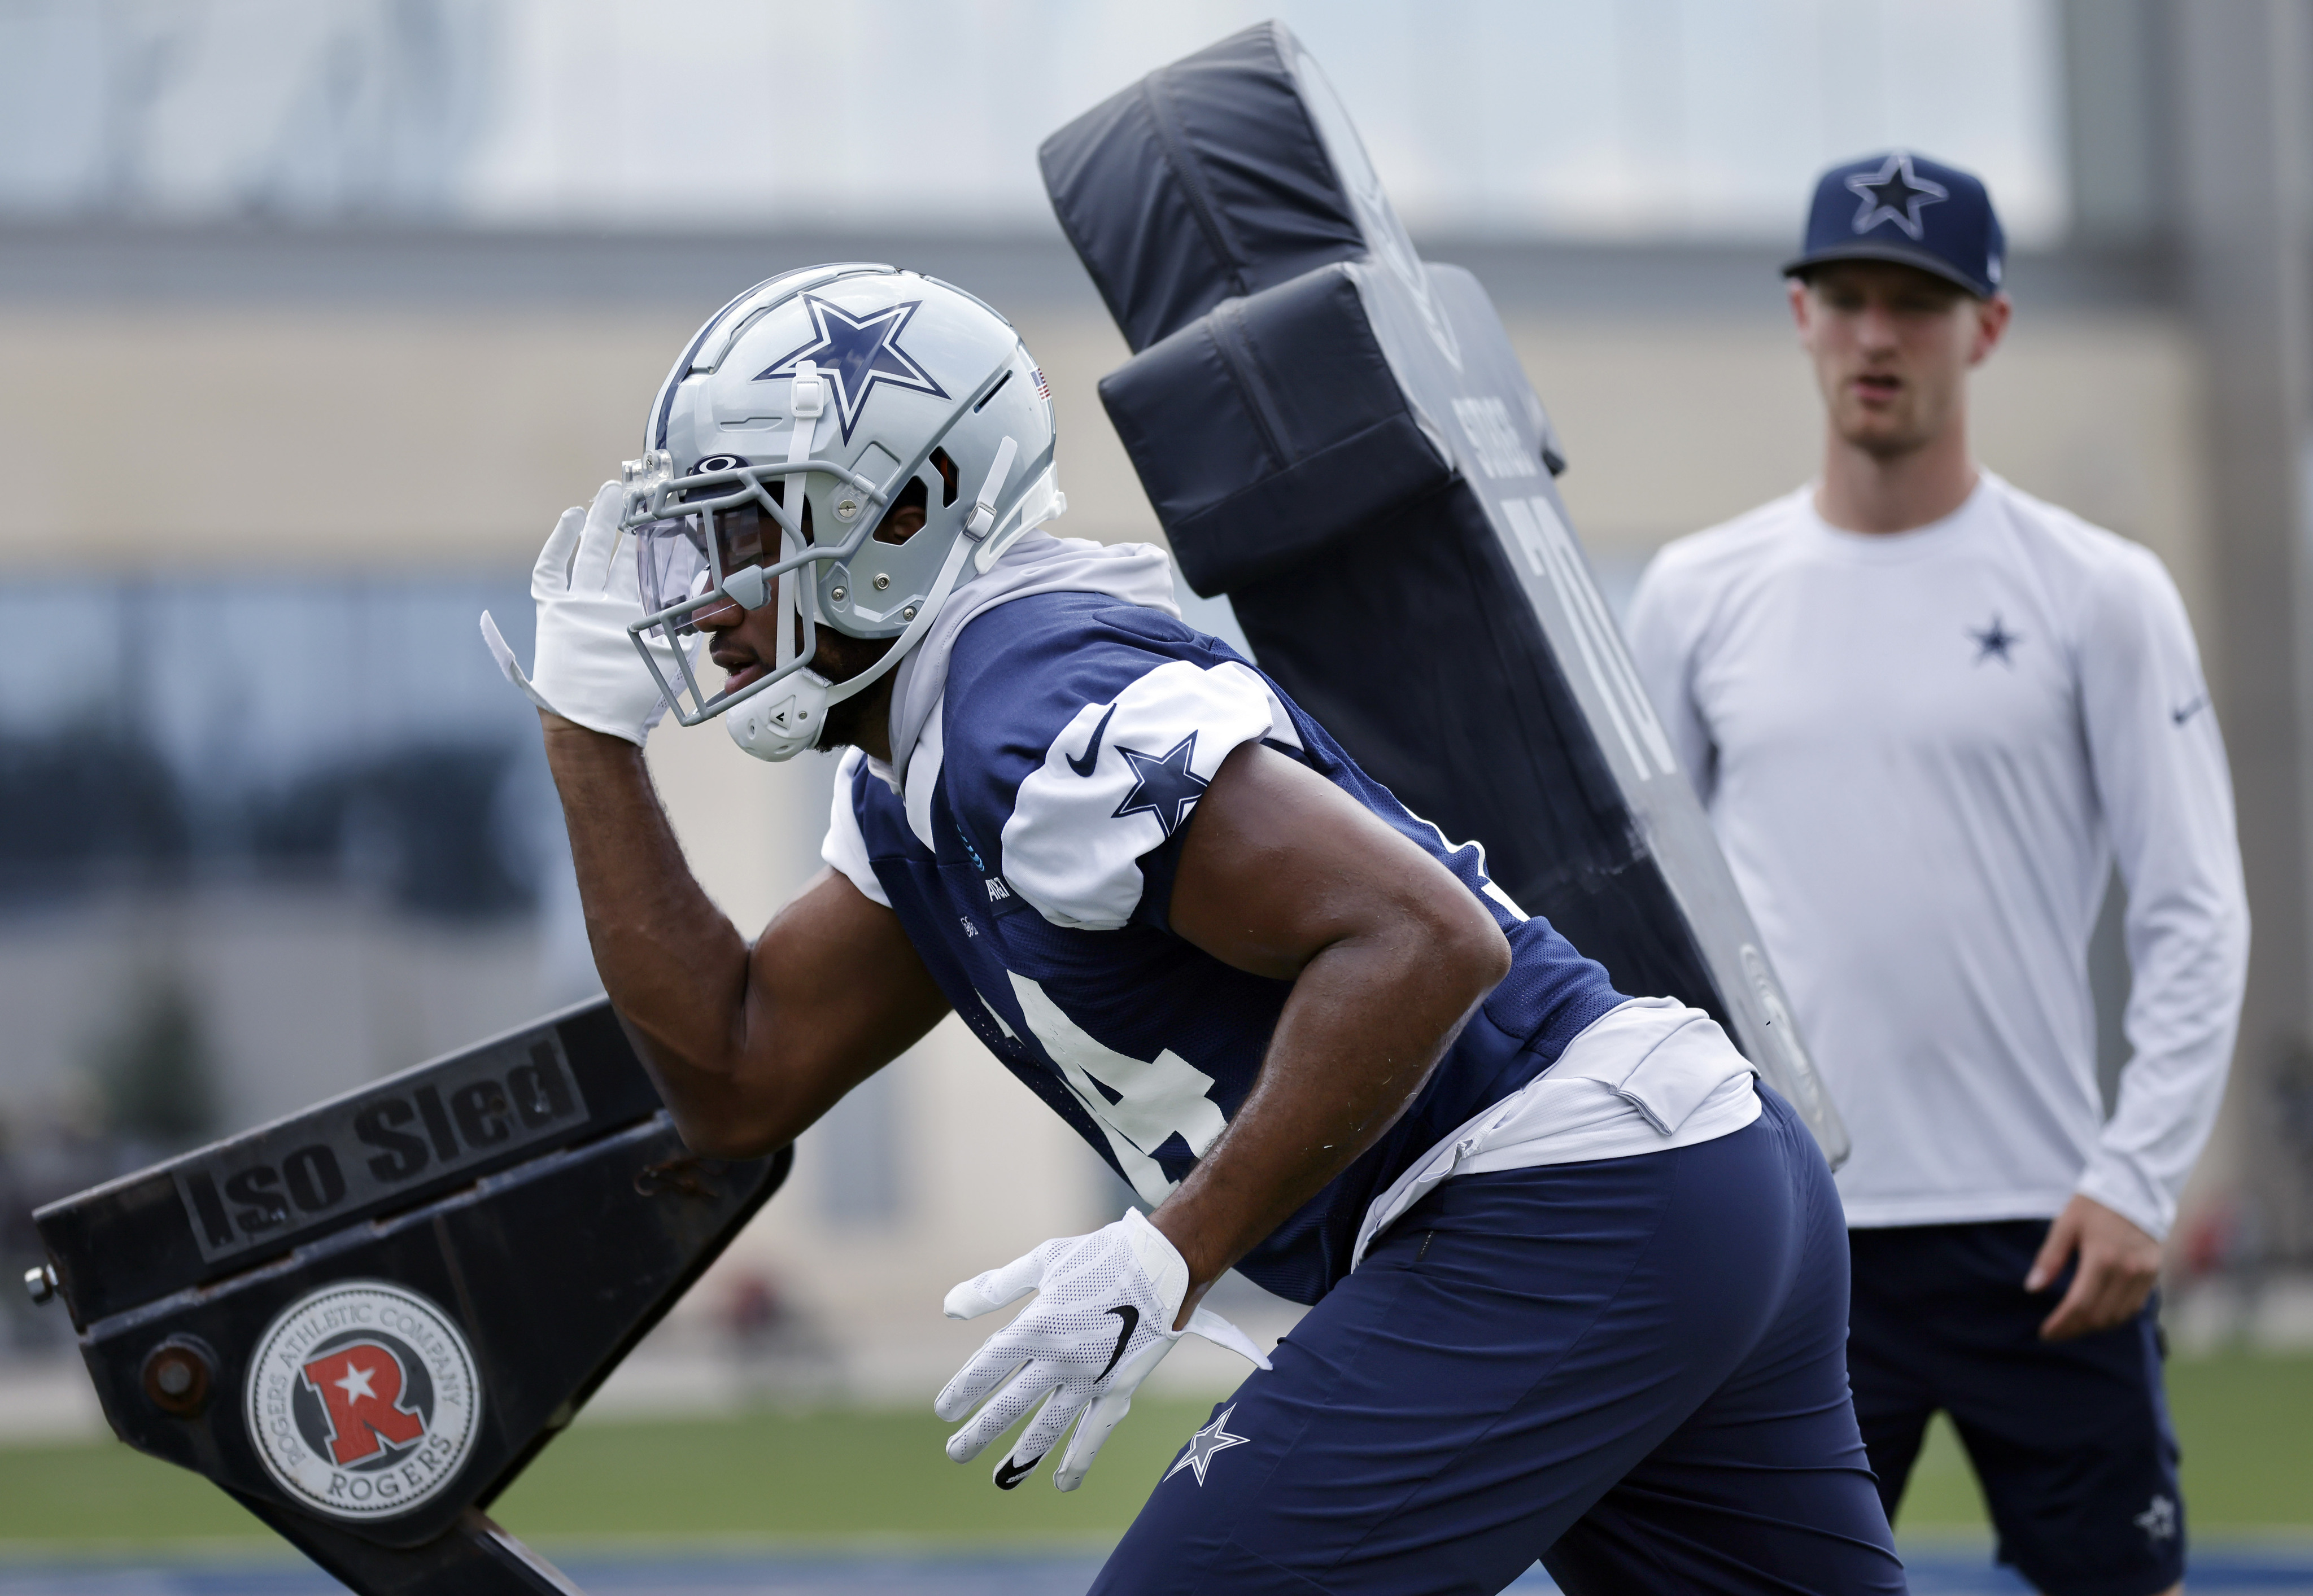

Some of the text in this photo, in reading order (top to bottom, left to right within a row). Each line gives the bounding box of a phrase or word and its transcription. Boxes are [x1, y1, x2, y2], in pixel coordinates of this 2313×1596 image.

[985, 877, 1010, 902] AT&T
[184, 1038, 576, 1249] Iso Sled
[267, 1302, 461, 1466] ROGERS ATHLETIC COMPANY
[326, 1432, 452, 1502] ROGERS
